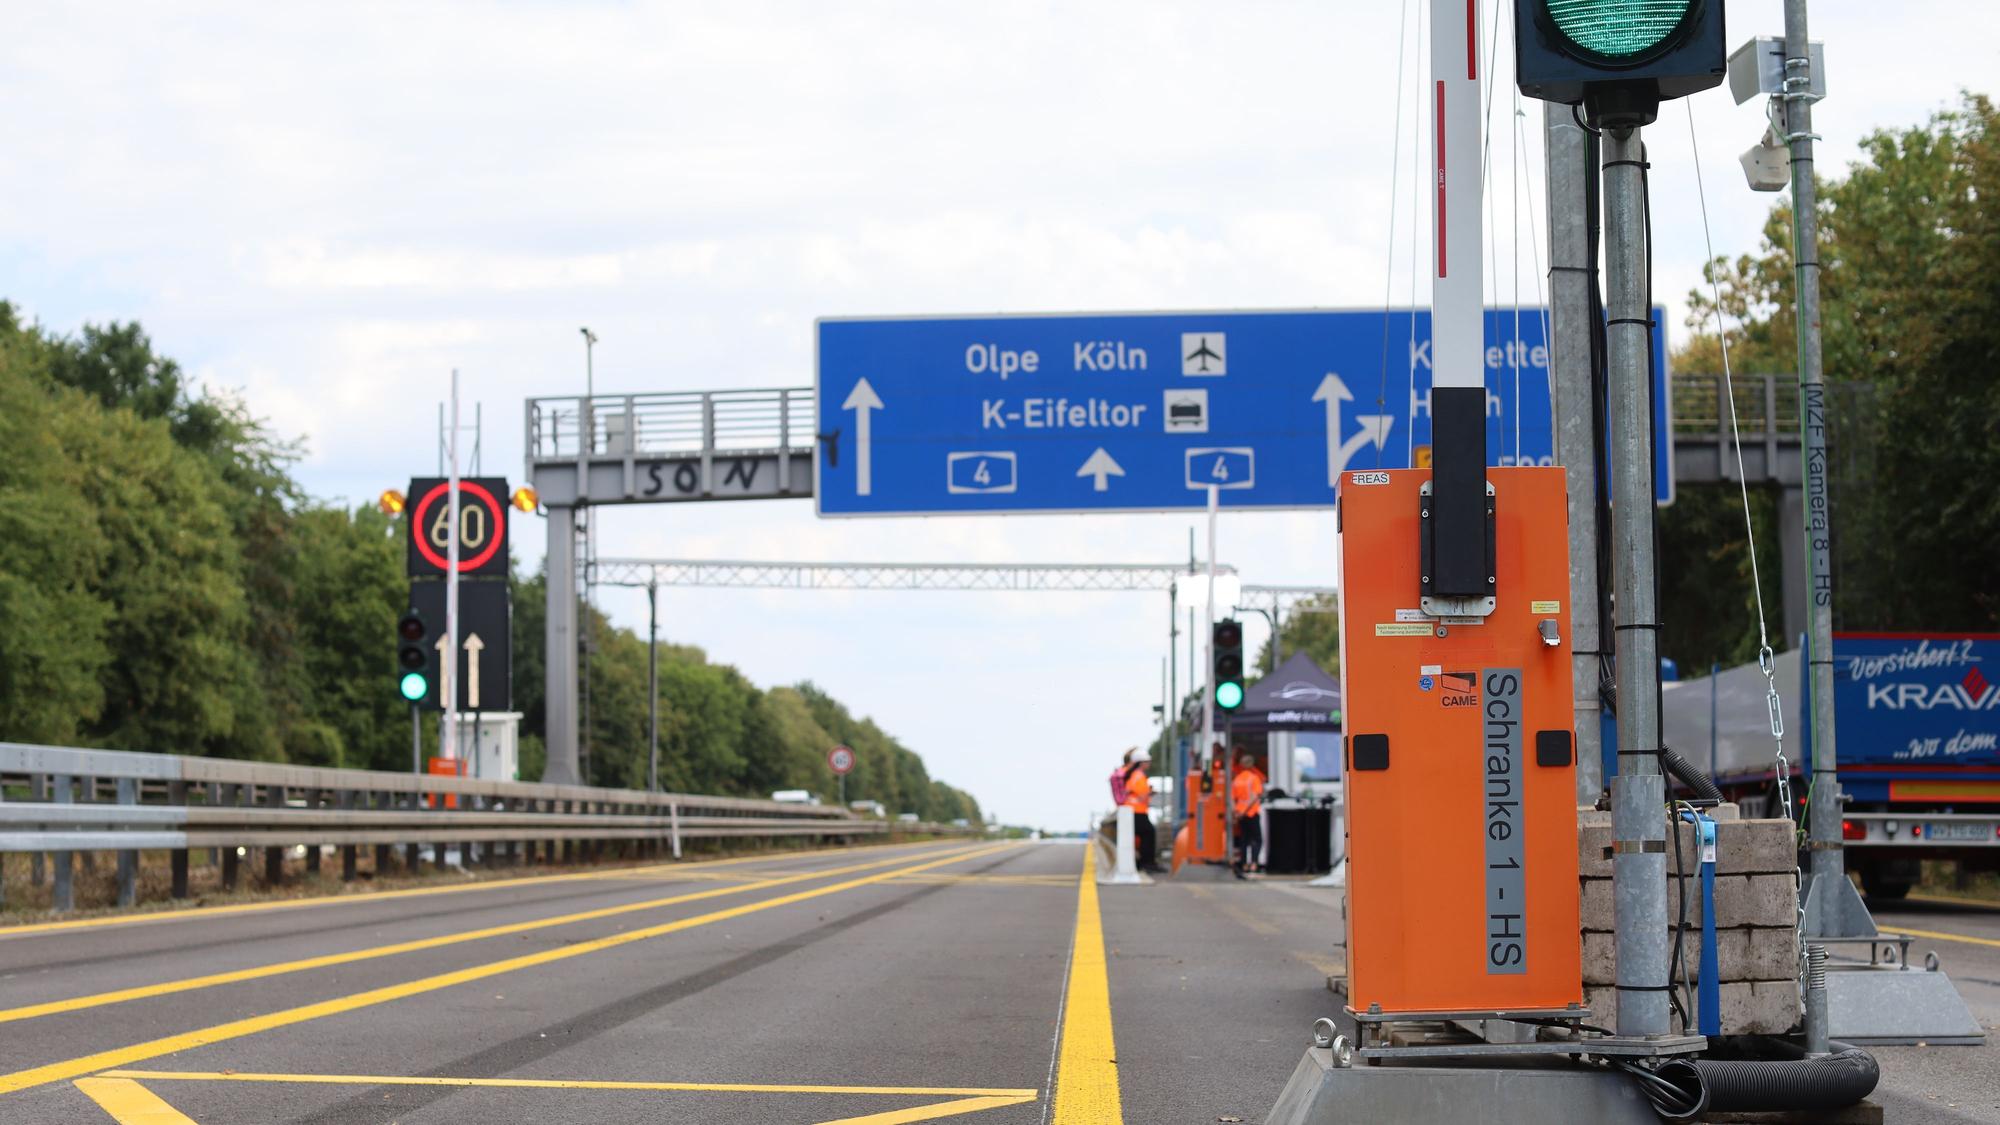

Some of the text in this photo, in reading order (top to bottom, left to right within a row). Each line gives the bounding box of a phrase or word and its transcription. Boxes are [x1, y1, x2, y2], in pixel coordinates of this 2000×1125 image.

[966, 340, 1147, 379] Olpe Köln
[982, 398, 1147, 429] K-Eifeltor
[1808, 390, 1824, 438] MZF
[973, 460, 991, 485] 4
[1211, 456, 1228, 481] 4
[1809, 447, 1827, 530] Kamera
[431, 504, 484, 549] 60
[1813, 537, 1829, 551] 8
[1815, 575, 1832, 607] HS
[1441, 696, 1477, 707] CAME
[1486, 673, 1522, 966] Schranke 1 - HS
